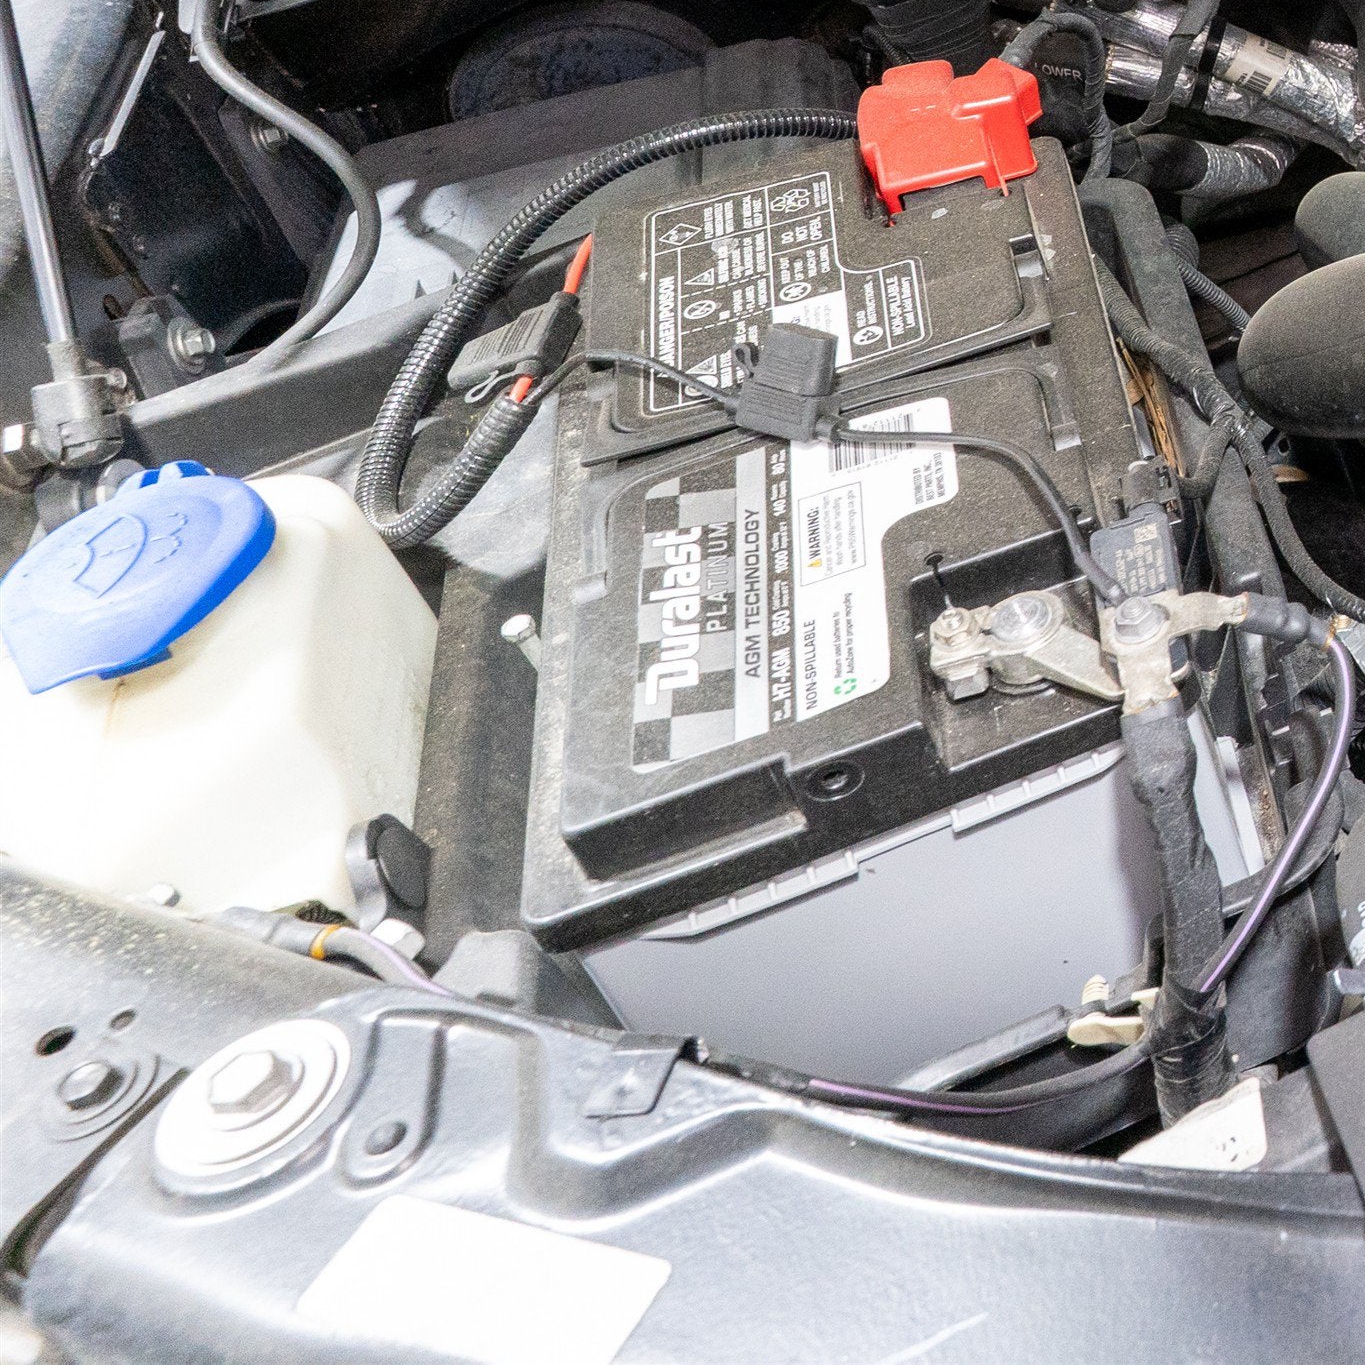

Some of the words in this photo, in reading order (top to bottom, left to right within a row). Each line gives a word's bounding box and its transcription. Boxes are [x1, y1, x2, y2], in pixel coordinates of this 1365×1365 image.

[781, 231, 794, 244] DO
[795, 225, 808, 242] NOT
[780, 257, 790, 269] OUT
[808, 258, 817, 277] REACH
[781, 270, 791, 284] KEEP
[901, 277, 912, 298] Battery
[886, 276, 904, 336] NON-SPILLABLE
[902, 298, 913, 311] Acid
[856, 311, 866, 328] READ
[904, 312, 915, 328] Lead
[771, 463, 785, 475] 80
[913, 475, 923, 505] DISTRIBUTED
[925, 489, 934, 501] BEST
[773, 499, 786, 516] 140
[807, 507, 821, 559] WARNING:
[743, 508, 760, 629] TECHNOLOGY
[774, 550, 789, 573] 1000
[706, 521, 728, 631] PLATINUM
[645, 525, 702, 705] Duralast
[843, 593, 853, 617] recycling
[772, 610, 790, 636] 850
[833, 619, 841, 643] batteries
[845, 619, 854, 636] proper
[745, 634, 761, 678] AGM
[804, 619, 817, 710] NON-SPILLABLE
[845, 647, 854, 674] AutoZone
[771, 647, 791, 701] H7-AGM
[834, 658, 842, 678] Return
